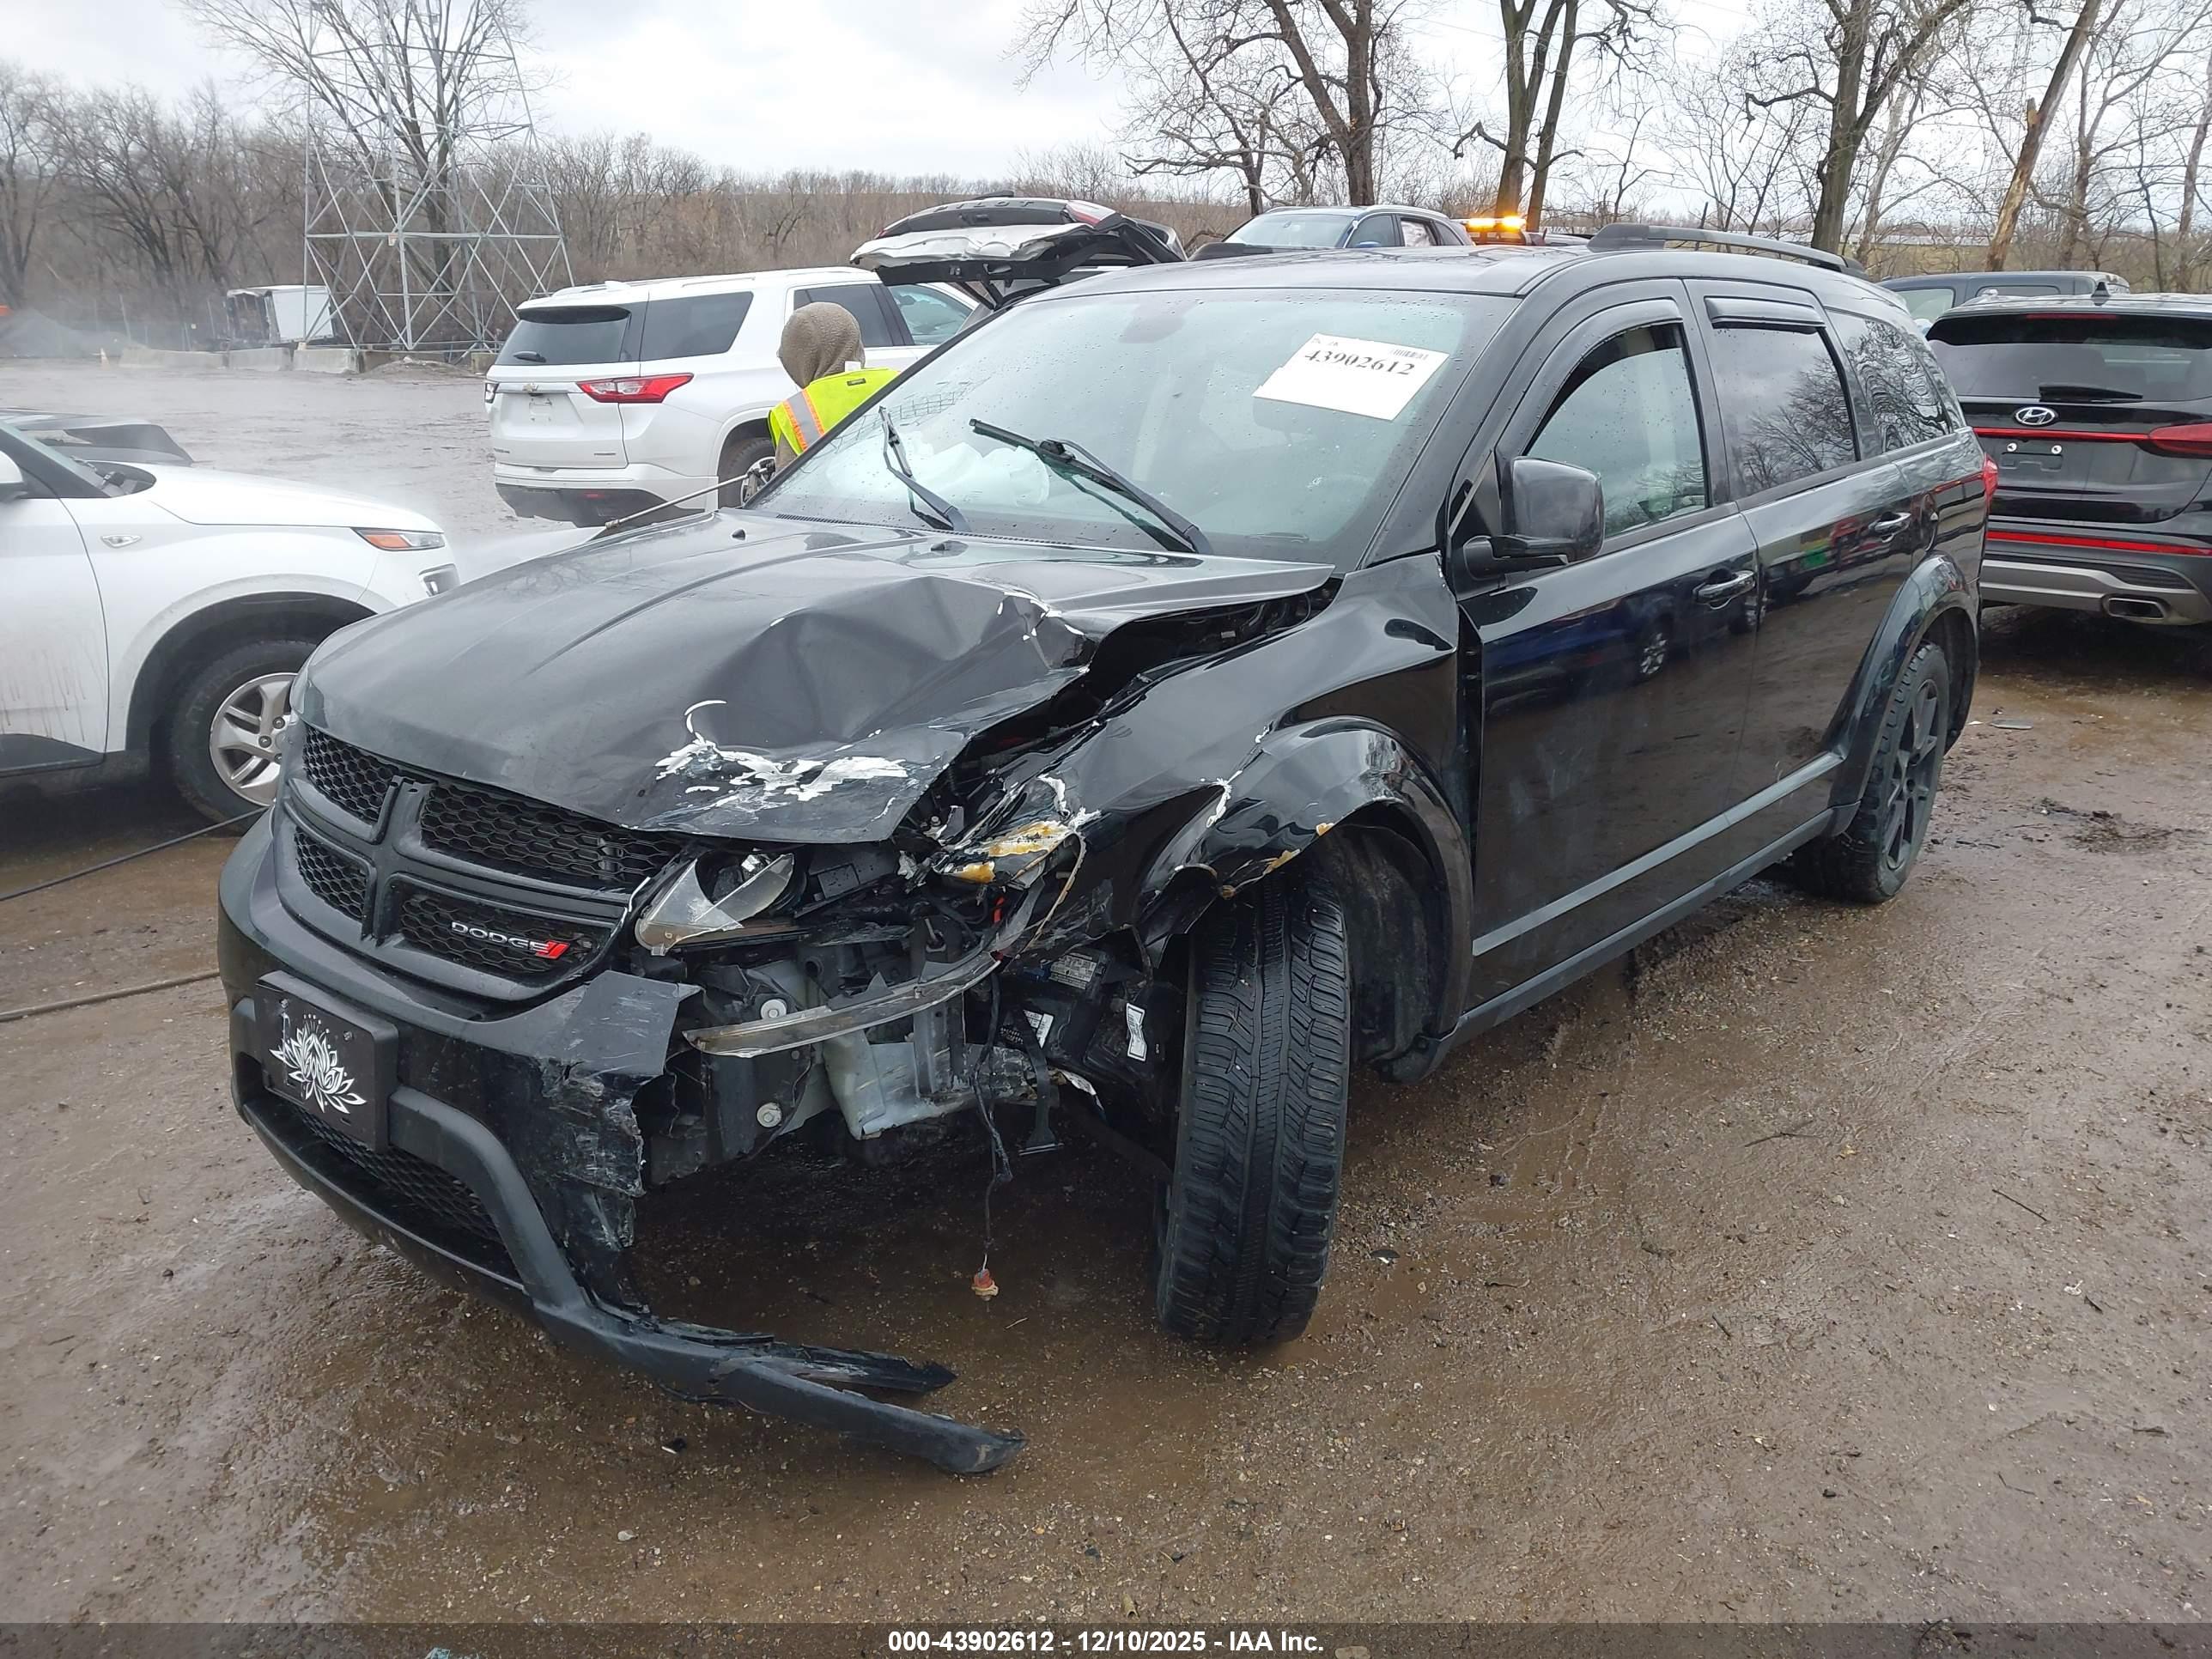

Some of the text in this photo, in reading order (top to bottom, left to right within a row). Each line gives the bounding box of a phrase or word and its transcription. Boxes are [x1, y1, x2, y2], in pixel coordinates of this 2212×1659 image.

[934, 200, 1035, 213] PILOT
[1304, 349, 1416, 376] 43902612
[451, 921, 550, 955] DODGE
